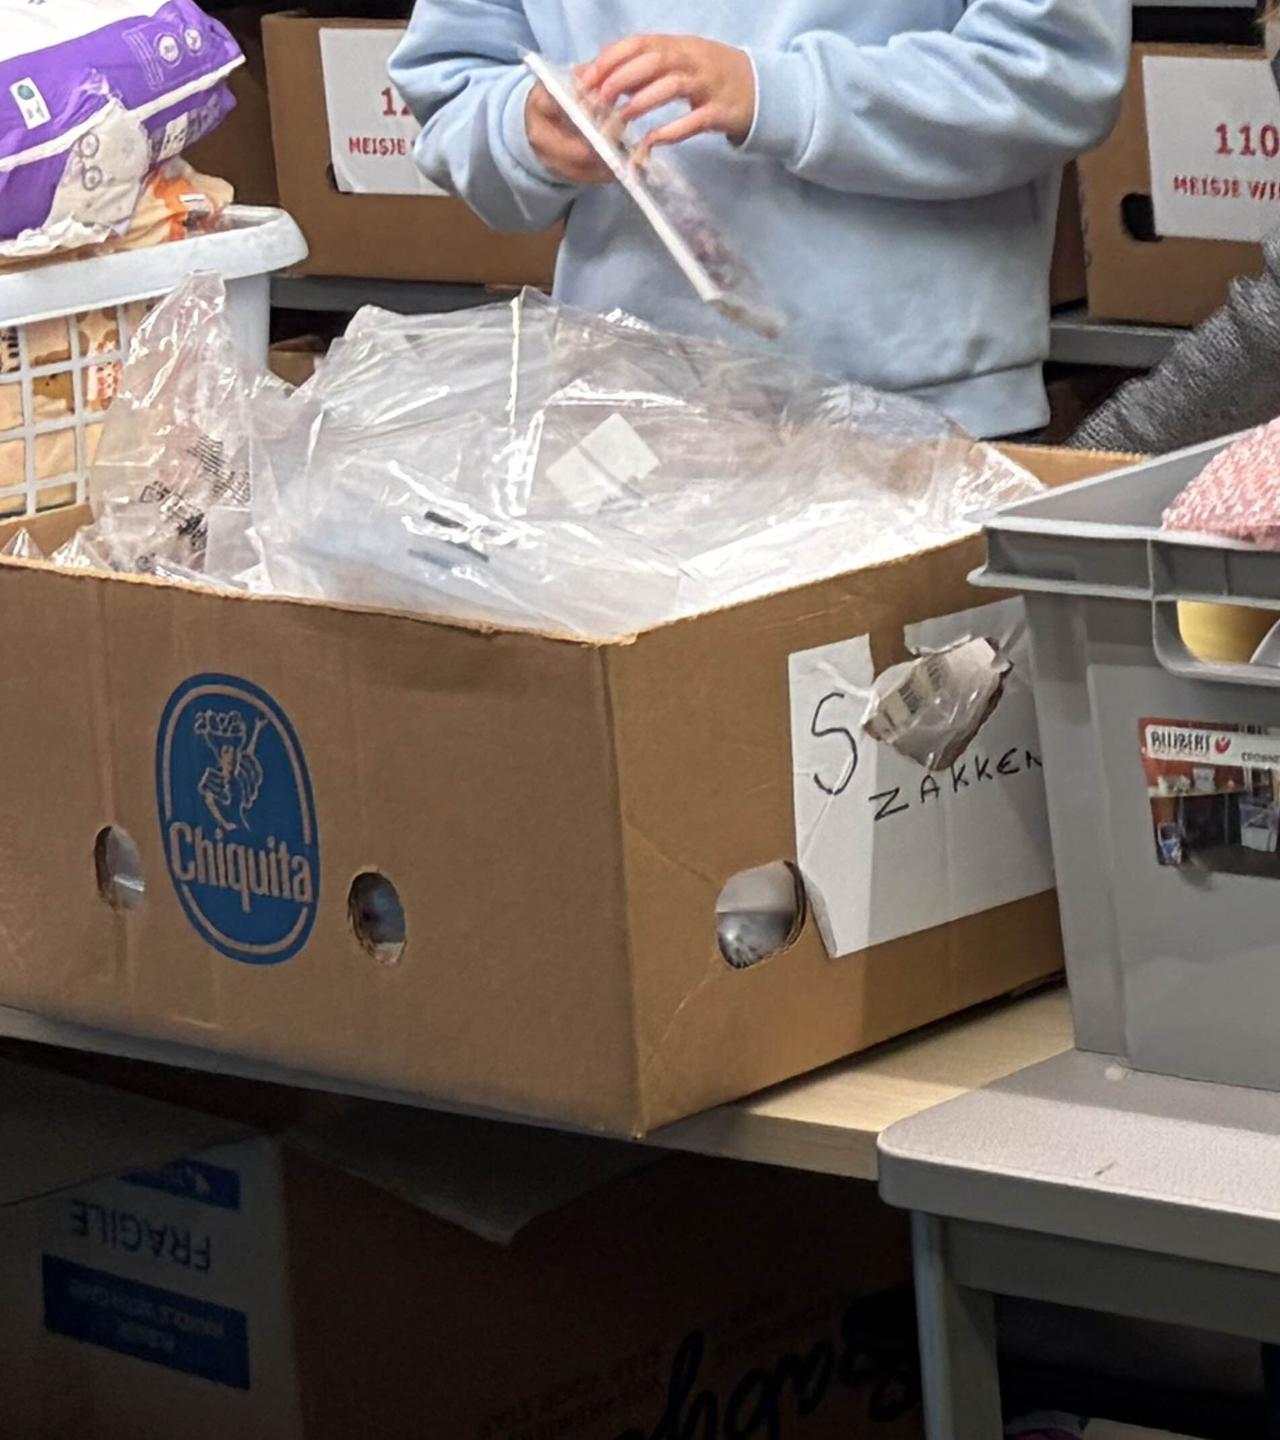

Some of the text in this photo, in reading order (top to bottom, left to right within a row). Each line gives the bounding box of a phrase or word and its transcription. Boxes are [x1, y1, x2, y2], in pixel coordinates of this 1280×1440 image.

[348, 136, 406, 157] MEISJE
[1215, 123, 1280, 158] 110
[1173, 173, 1242, 201] MEISJE
[811, 691, 858, 796] S
[166, 818, 314, 915] Chiquita
[68, 1197, 212, 1274] FRAGILE
